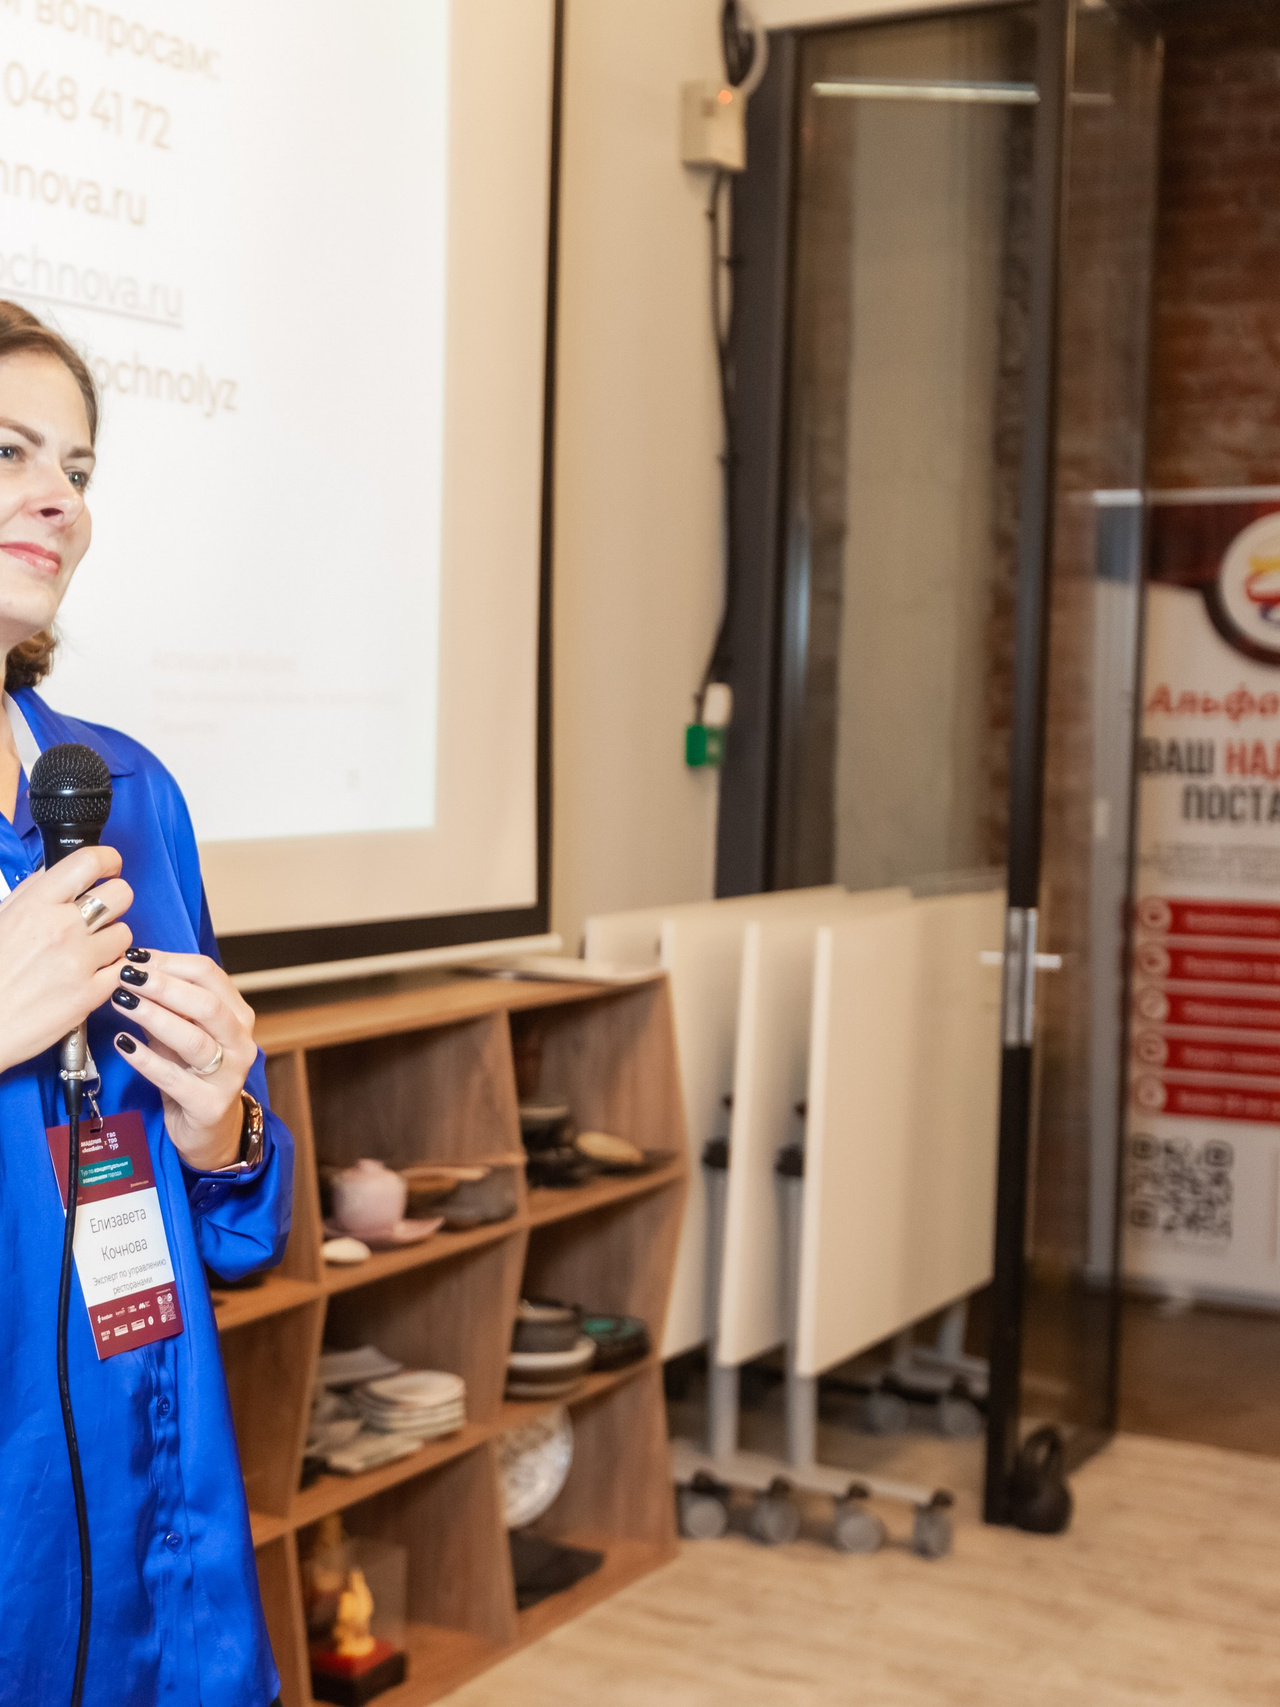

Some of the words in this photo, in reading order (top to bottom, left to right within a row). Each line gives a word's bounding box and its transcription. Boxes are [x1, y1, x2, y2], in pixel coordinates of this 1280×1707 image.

[3, 61, 78, 122] 048
[90, 88, 123, 135] 41
[132, 98, 172, 150] 72
[87, 347, 240, 418] ochnolyz
[90, 1208, 146, 1233] Елизавета
[101, 1238, 148, 1261] Кочнова
[92, 1273, 119, 1286] Эксперт
[119, 1270, 128, 1279] по
[128, 1259, 167, 1277] управлению
[113, 1276, 153, 1295] ресторанами
